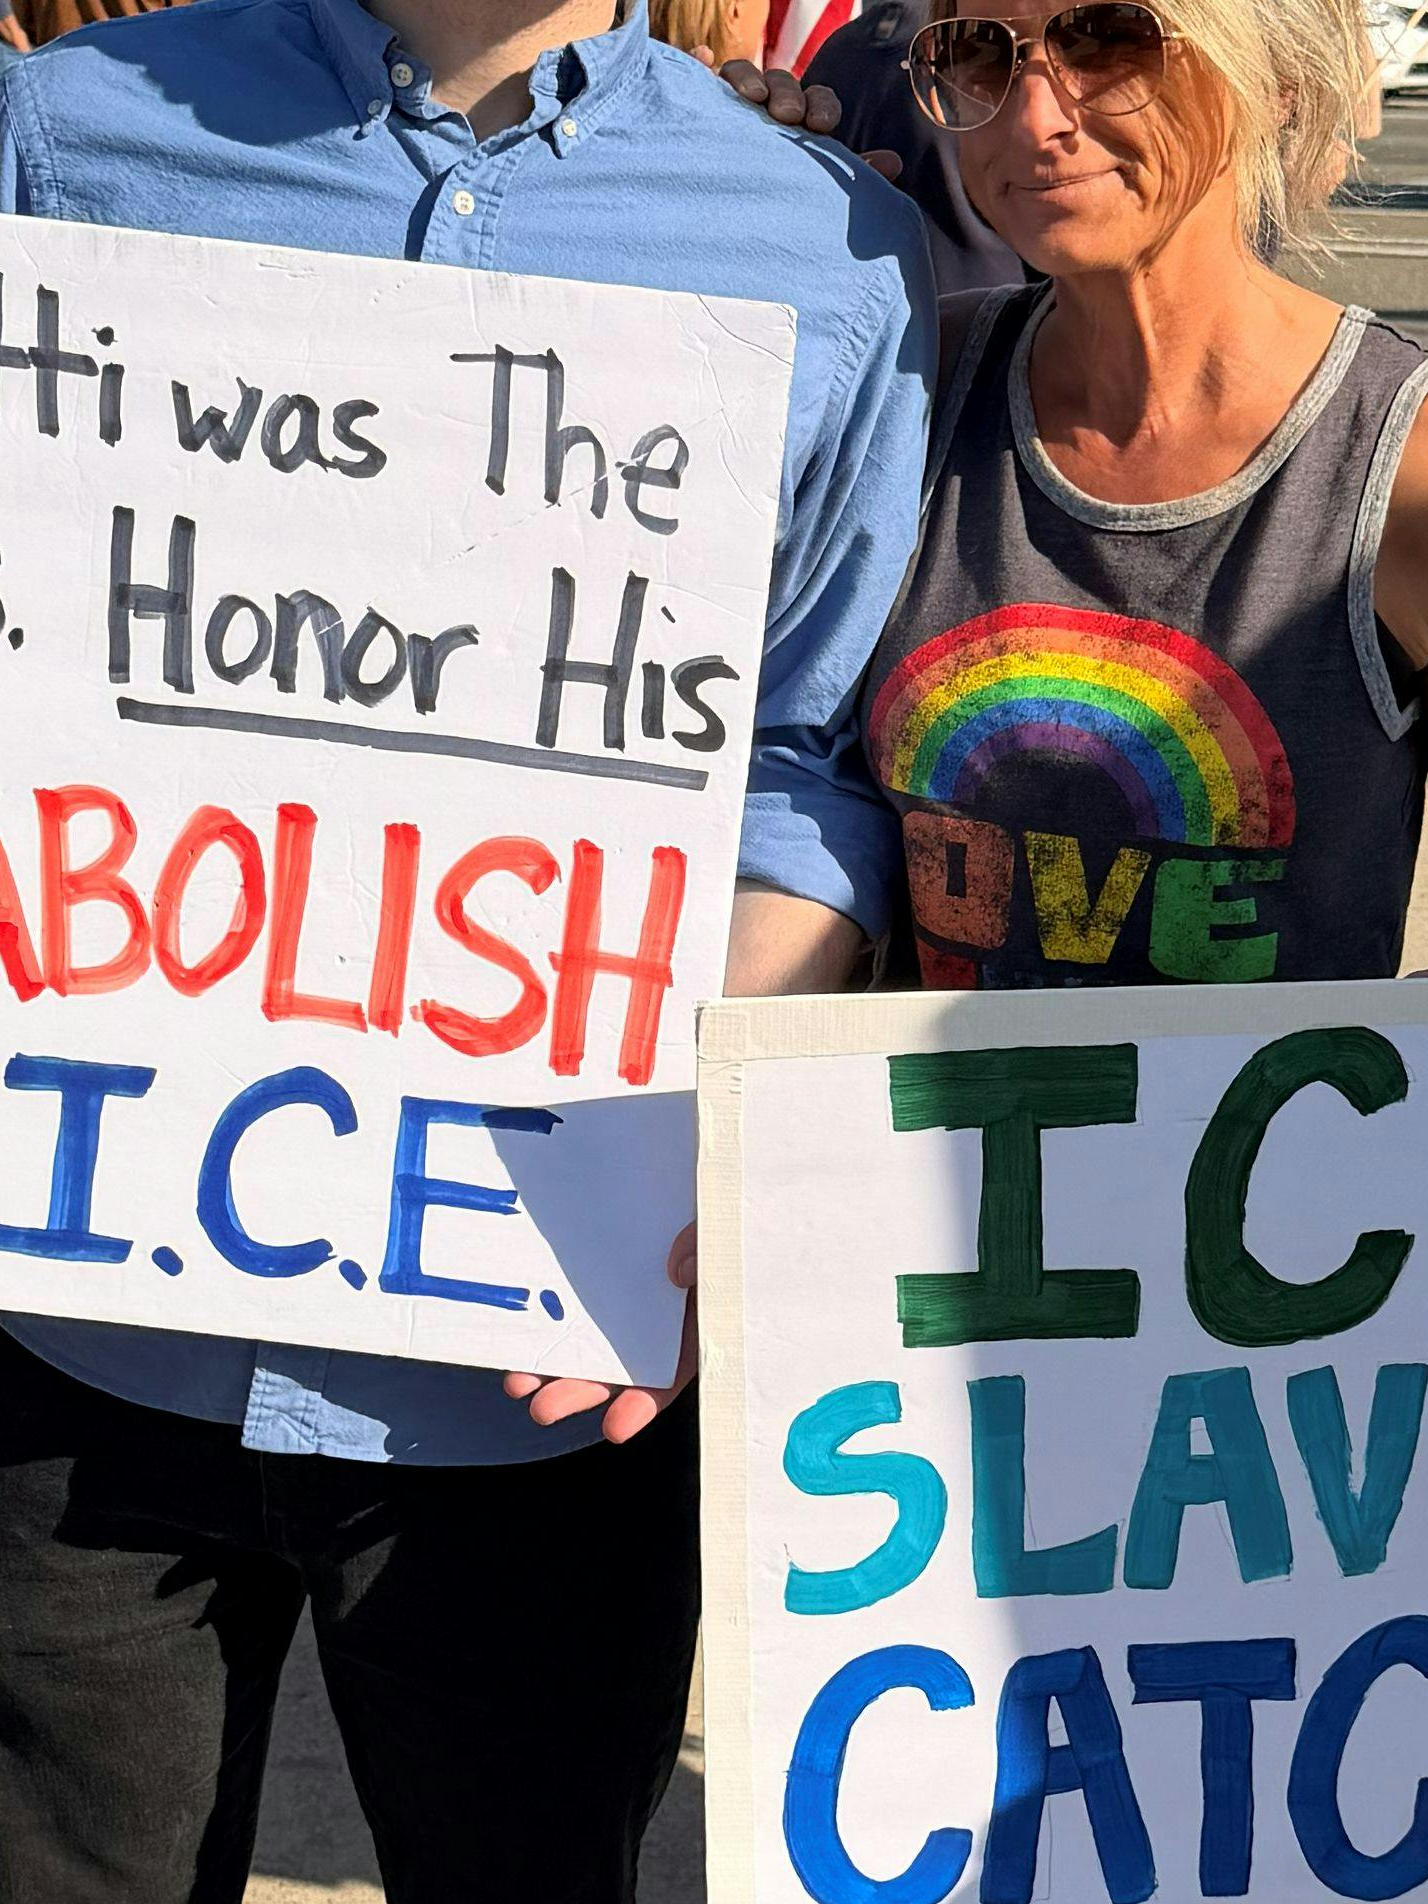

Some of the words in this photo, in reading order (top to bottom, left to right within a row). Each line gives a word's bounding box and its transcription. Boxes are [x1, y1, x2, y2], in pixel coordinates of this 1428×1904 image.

[171, 375, 389, 480] was
[448, 343, 691, 537] The
[107, 504, 480, 716] Honor
[535, 566, 741, 753] His
